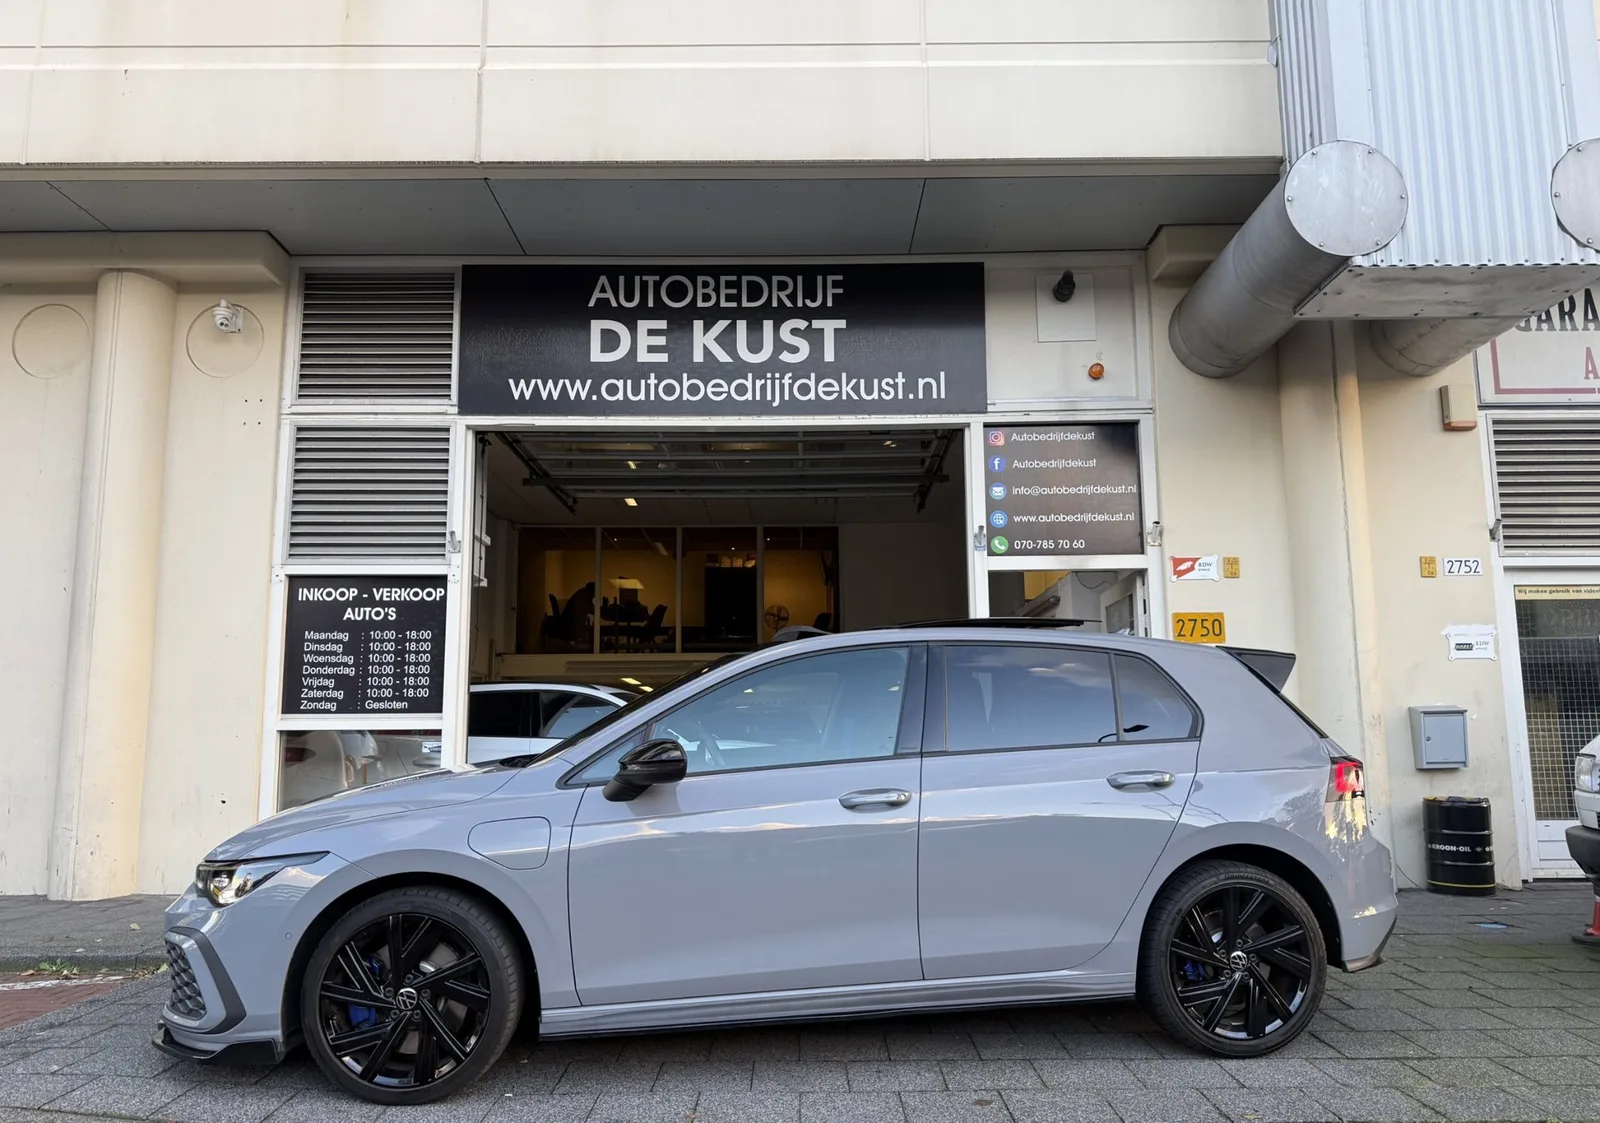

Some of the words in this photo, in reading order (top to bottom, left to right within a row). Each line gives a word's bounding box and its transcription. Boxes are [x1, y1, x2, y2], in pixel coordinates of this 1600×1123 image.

[588, 275, 843, 308] AUTOBEDRIJF
[589, 319, 669, 363] DE
[692, 318, 847, 364] KUST
[508, 370, 946, 406] www.autobedrijfdekust.nl
[1011, 431, 1095, 442] Autobedrijfdekust
[1012, 458, 1097, 469] Autobedrijfdekust
[1013, 512, 1135, 524] www.autobedrijfdekust.nl
[1014, 539, 1055, 550] 070-785
[1057, 539, 1070, 549] 70
[1072, 539, 1085, 549] 60
[1446, 559, 1481, 574] 2752
[298, 587, 358, 601] INKOOP
[372, 587, 445, 601] VERKOOP
[343, 607, 397, 621] AUTO'S
[1176, 618, 1222, 637] 2750
[305, 631, 349, 641] Maandag
[370, 631, 395, 639] 10:00
[405, 631, 431, 639] 18:00
[304, 643, 343, 652] Dinsdag
[303, 654, 353, 664] Woensdag
[368, 654, 394, 662] 10:00
[405, 654, 430, 662] 18:00
[303, 666, 355, 675] Donderdag
[368, 666, 393, 674] 10:00
[302, 677, 334, 687] Vrijdag
[367, 677, 393, 685] 10:00
[403, 677, 429, 685] 18:00
[301, 689, 343, 699] Zaterdag
[366, 689, 392, 697] 10:00
[403, 689, 428, 697] 18:00
[300, 701, 336, 711] Zondag
[365, 701, 407, 709] Gesloten
[1432, 844, 1472, 852] KROON-OIL
